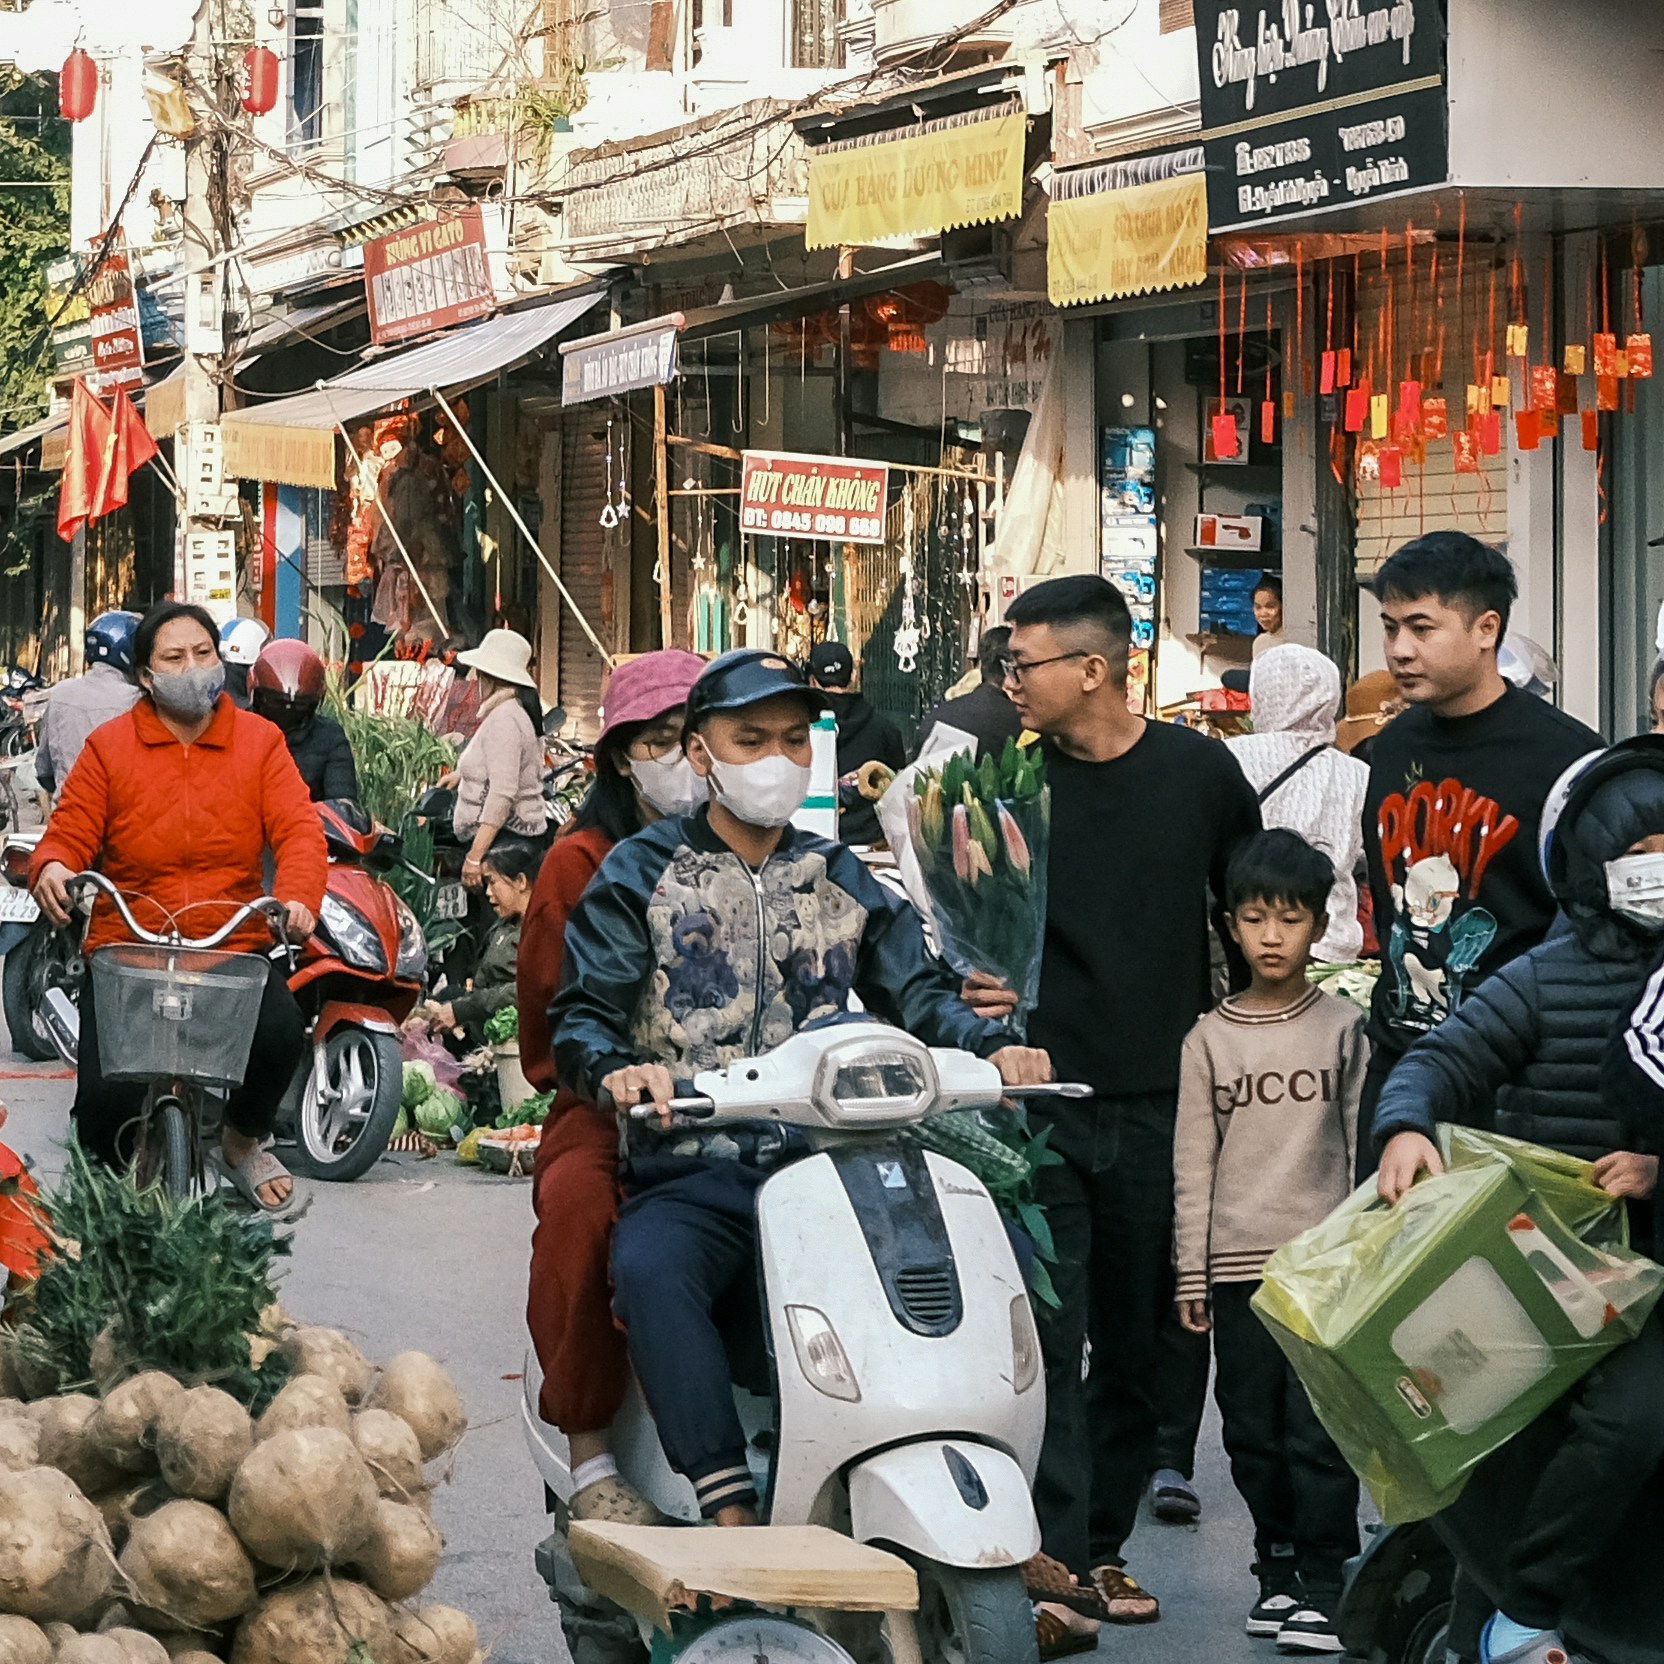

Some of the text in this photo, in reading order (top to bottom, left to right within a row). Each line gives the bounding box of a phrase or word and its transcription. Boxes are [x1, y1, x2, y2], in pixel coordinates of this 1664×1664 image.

[747, 459, 881, 512] HÚT CHÂN KHÔNG
[1378, 776, 1520, 899] PORKY
[1214, 1068, 1333, 1115] GUCCI
